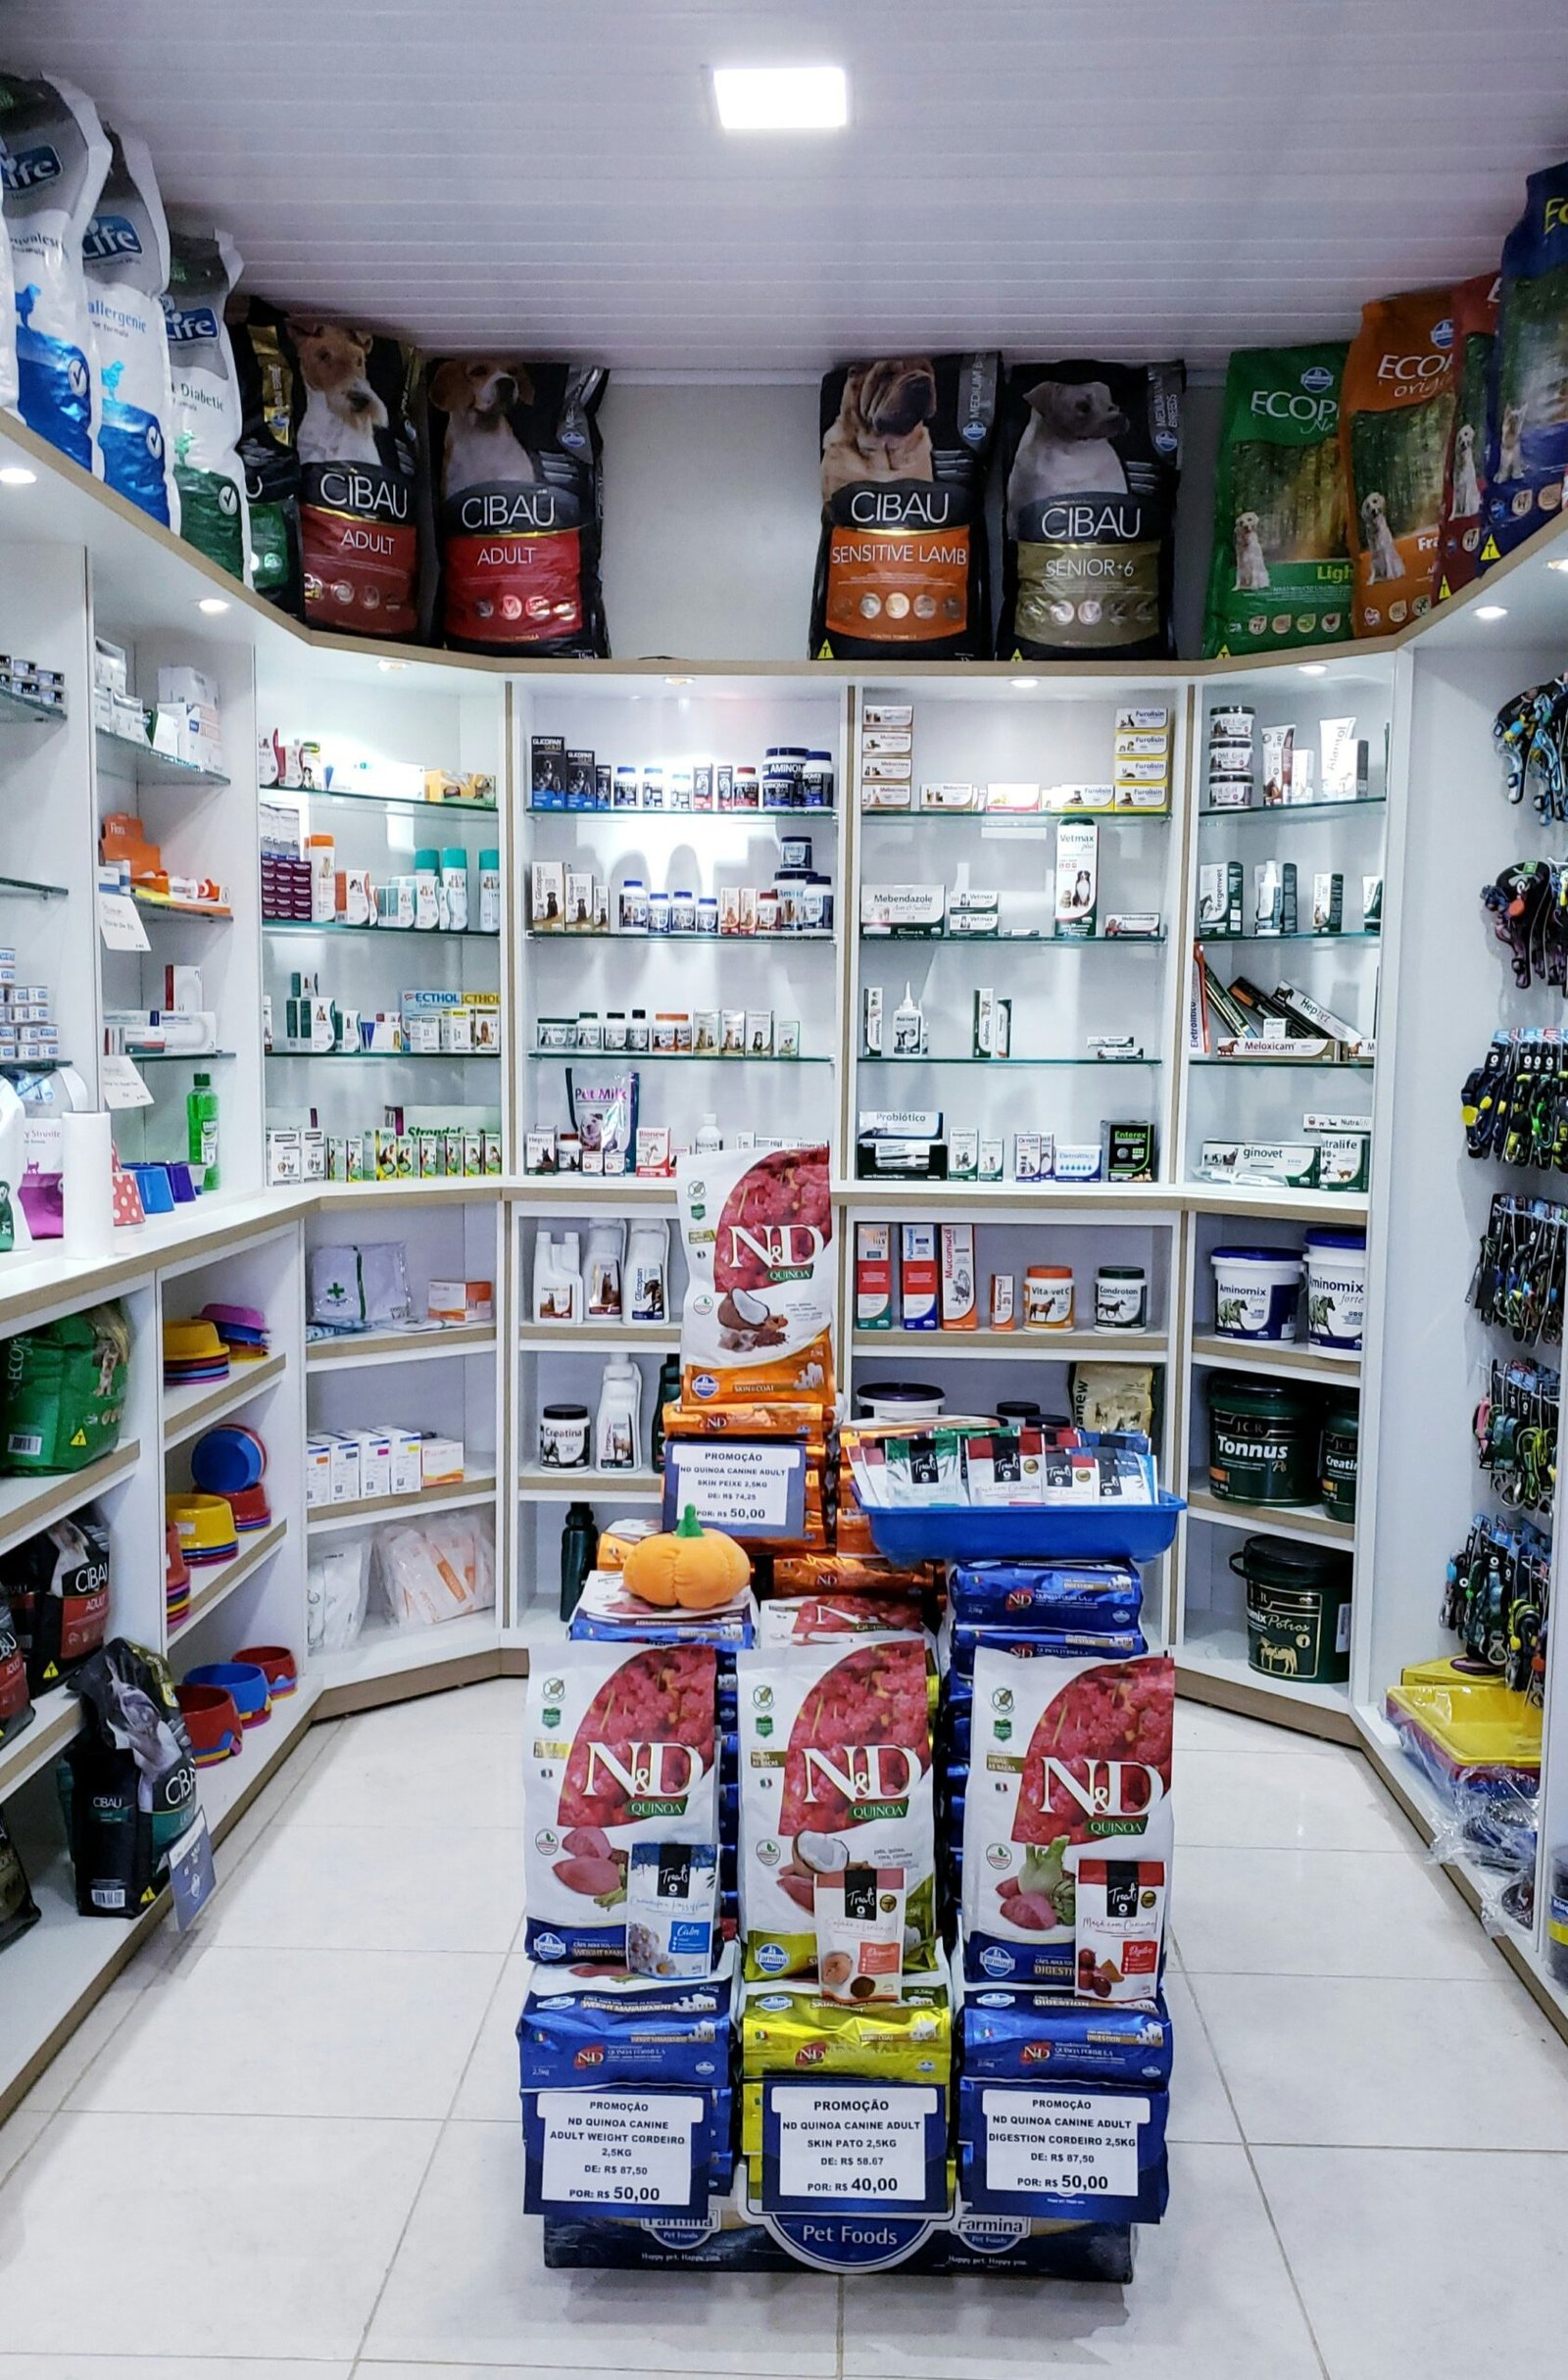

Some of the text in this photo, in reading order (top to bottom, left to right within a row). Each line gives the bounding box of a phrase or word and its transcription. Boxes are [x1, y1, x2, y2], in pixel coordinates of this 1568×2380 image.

[320, 473, 408, 519] CIBAU
[461, 494, 556, 530] CIBAU
[851, 490, 950, 523] CIBAU
[1041, 507, 1142, 540] CIBAU
[341, 528, 395, 556] ADULT
[476, 547, 537, 566] ADULT
[831, 544, 967, 565] SENSITIVE LAMB
[1045, 559, 1113, 578] SENIOR
[1059, 834, 1095, 843] Vetmax
[1215, 868, 1224, 913] Tergenvet
[873, 894, 933, 904] Mebendazole
[416, 993, 461, 1004] ECTHOL
[1245, 1042, 1295, 1051] Meloxicam
[575, 1088, 596, 1100] Pet
[1114, 1130, 1147, 1140] Enterex
[1243, 1146, 1284, 1159] ginovet
[943, 1229, 954, 1279] Mucomucil
[769, 1270, 811, 1281] QUINOA
[1219, 1284, 1267, 1296] Aminomix
[545, 1428, 582, 1438] Creatina
[1217, 1435, 1289, 1459] Tonnus
[705, 1451, 762, 1463] PROMOÇÃO
[730, 1508, 765, 1520] 50,00
[1267, 1615, 1310, 1633] Potros
[631, 1802, 682, 1814] QUINOA
[853, 1805, 905, 1819] QUINOA
[1090, 1821, 1143, 1834] QUINOA
[590, 2101, 649, 2113] PROMOÇÃO
[813, 2099, 890, 2113] PROMOÇÃO
[1032, 2099, 1092, 2111] PROMOÇÃO
[586, 2118, 626, 2127] QUINOA
[629, 2120, 669, 2129] CANINE
[783, 2121, 921, 2131] ND QUINOA CANINE ADULT
[993, 2115, 1132, 2129] ND QUINOA CANINE ADULT
[550, 2131, 685, 2145] ADULT WEIGHT CORDEIRO
[808, 2139, 897, 2149] SKIN PATO 2,5KG
[989, 2132, 1136, 2148] DIGESTION CORDEIRO 2,5KG
[602, 2148, 632, 2158] 2,5KG
[1031, 2153, 1095, 2164] DE: R$ 87,50
[820, 2157, 838, 2165] DE:
[840, 2157, 854, 2166] R$
[584, 2164, 648, 2176] DE: R$ 87,50
[808, 2177, 898, 2193] POR: R$ 40,00
[1017, 2174, 1108, 2191] POR: R$ 50,00
[569, 2186, 660, 2202] POR: R$ 50,00
[956, 2216, 1023, 2234] Farmina
[803, 2224, 898, 2246] Pet Foods
